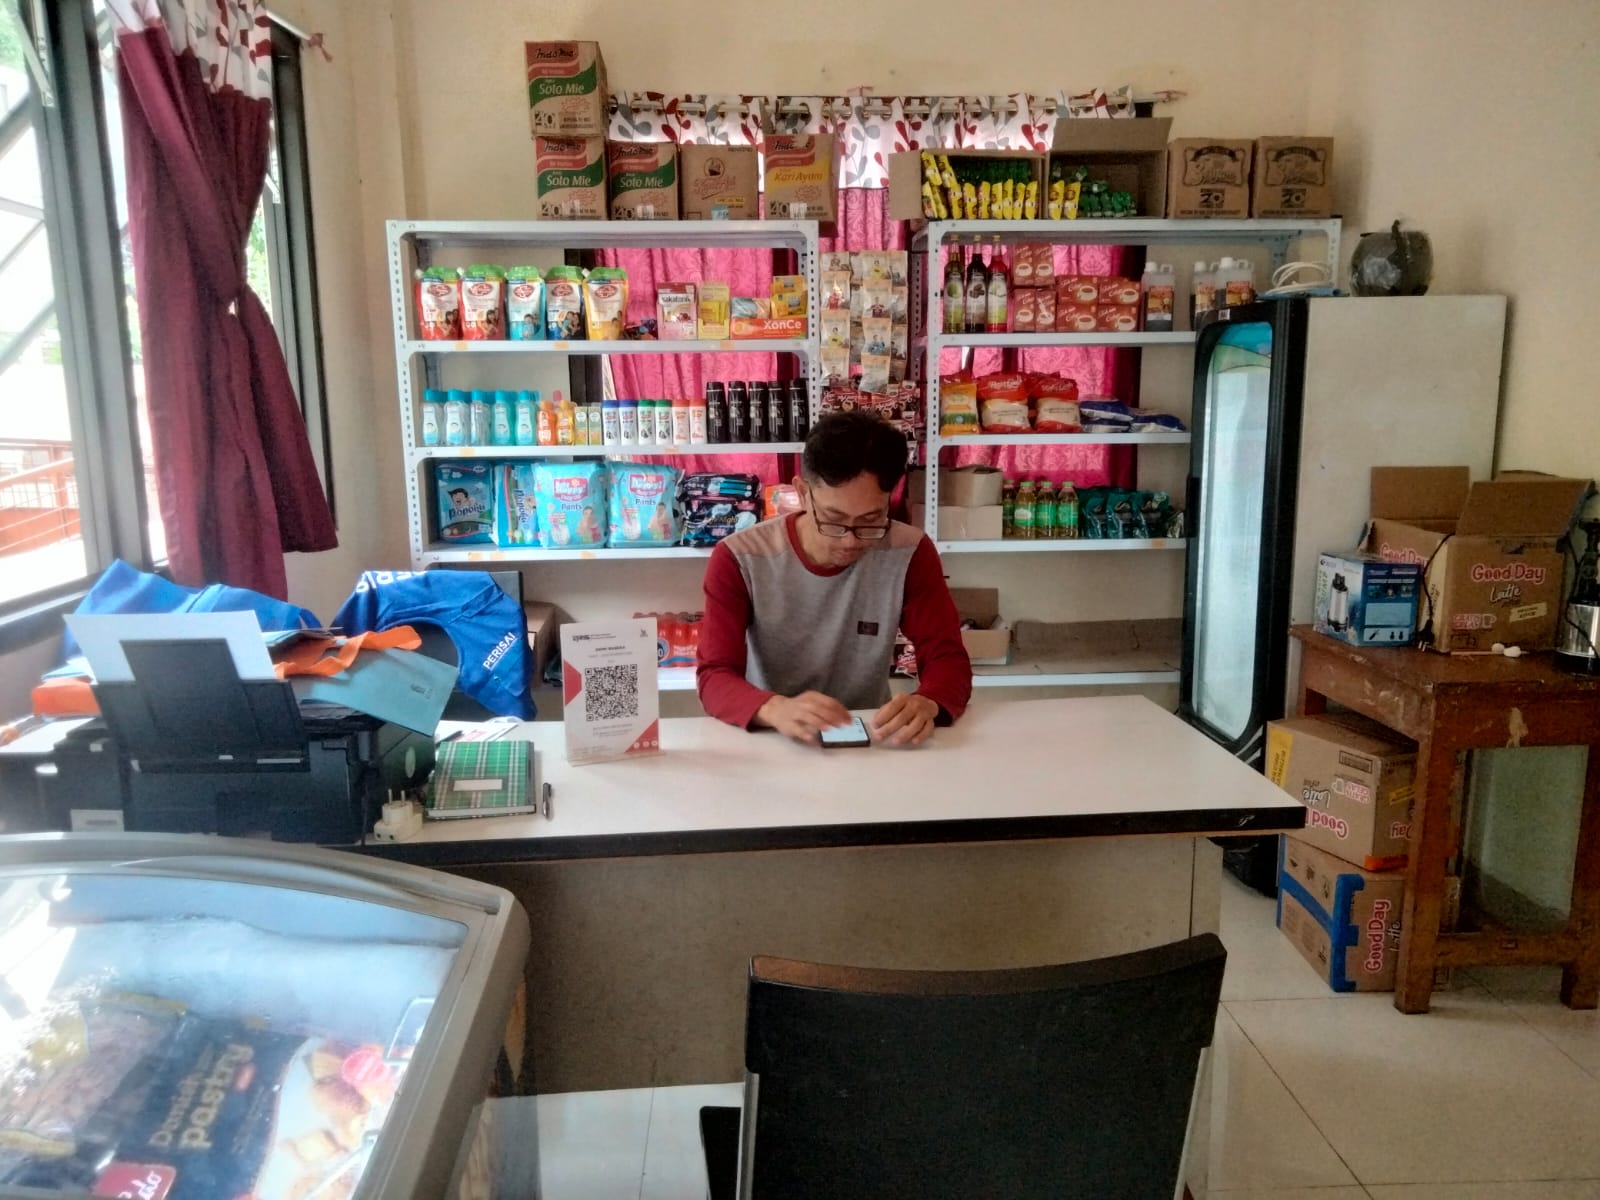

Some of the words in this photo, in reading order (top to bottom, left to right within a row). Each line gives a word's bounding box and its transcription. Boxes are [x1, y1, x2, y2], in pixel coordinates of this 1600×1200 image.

[565, 82, 585, 94] Mie
[571, 175, 592, 187] Mie
[644, 177, 663, 188] Mie
[774, 172, 794, 182] Kari
[795, 171, 823, 184] Ayam
[763, 318, 802, 330] XonCe
[1472, 563, 1512, 582] Good
[1514, 562, 1546, 585] Day
[1490, 584, 1521, 603] Latte
[483, 631, 517, 671] PERISAI
[1303, 788, 1331, 809] Latte
[1311, 809, 1348, 839] Good
[1366, 899, 1392, 932] Day
[1363, 932, 1386, 973] Good
